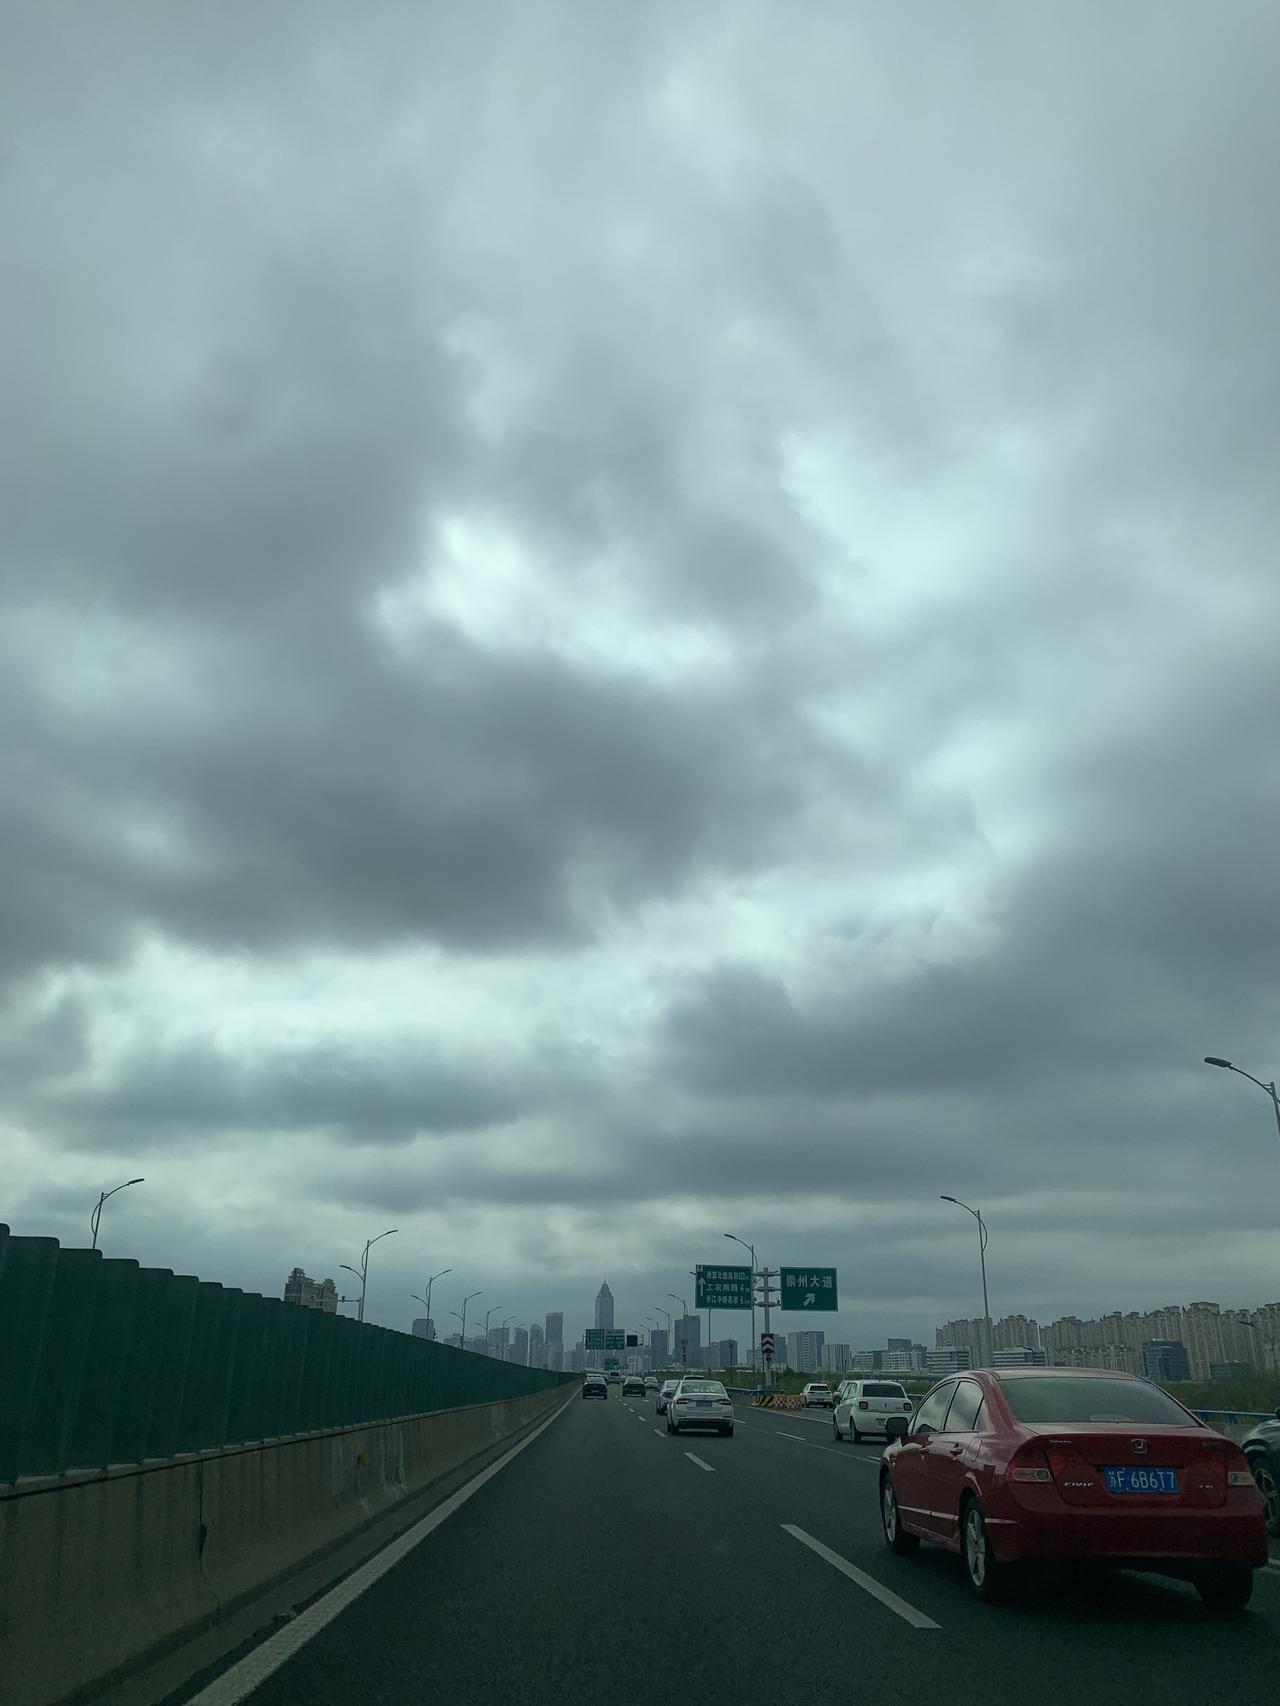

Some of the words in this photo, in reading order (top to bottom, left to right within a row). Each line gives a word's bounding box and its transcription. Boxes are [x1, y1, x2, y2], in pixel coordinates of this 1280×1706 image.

[786, 1274, 833, 1288] 崇州大道
[706, 1283, 738, 1292] 工农南路
